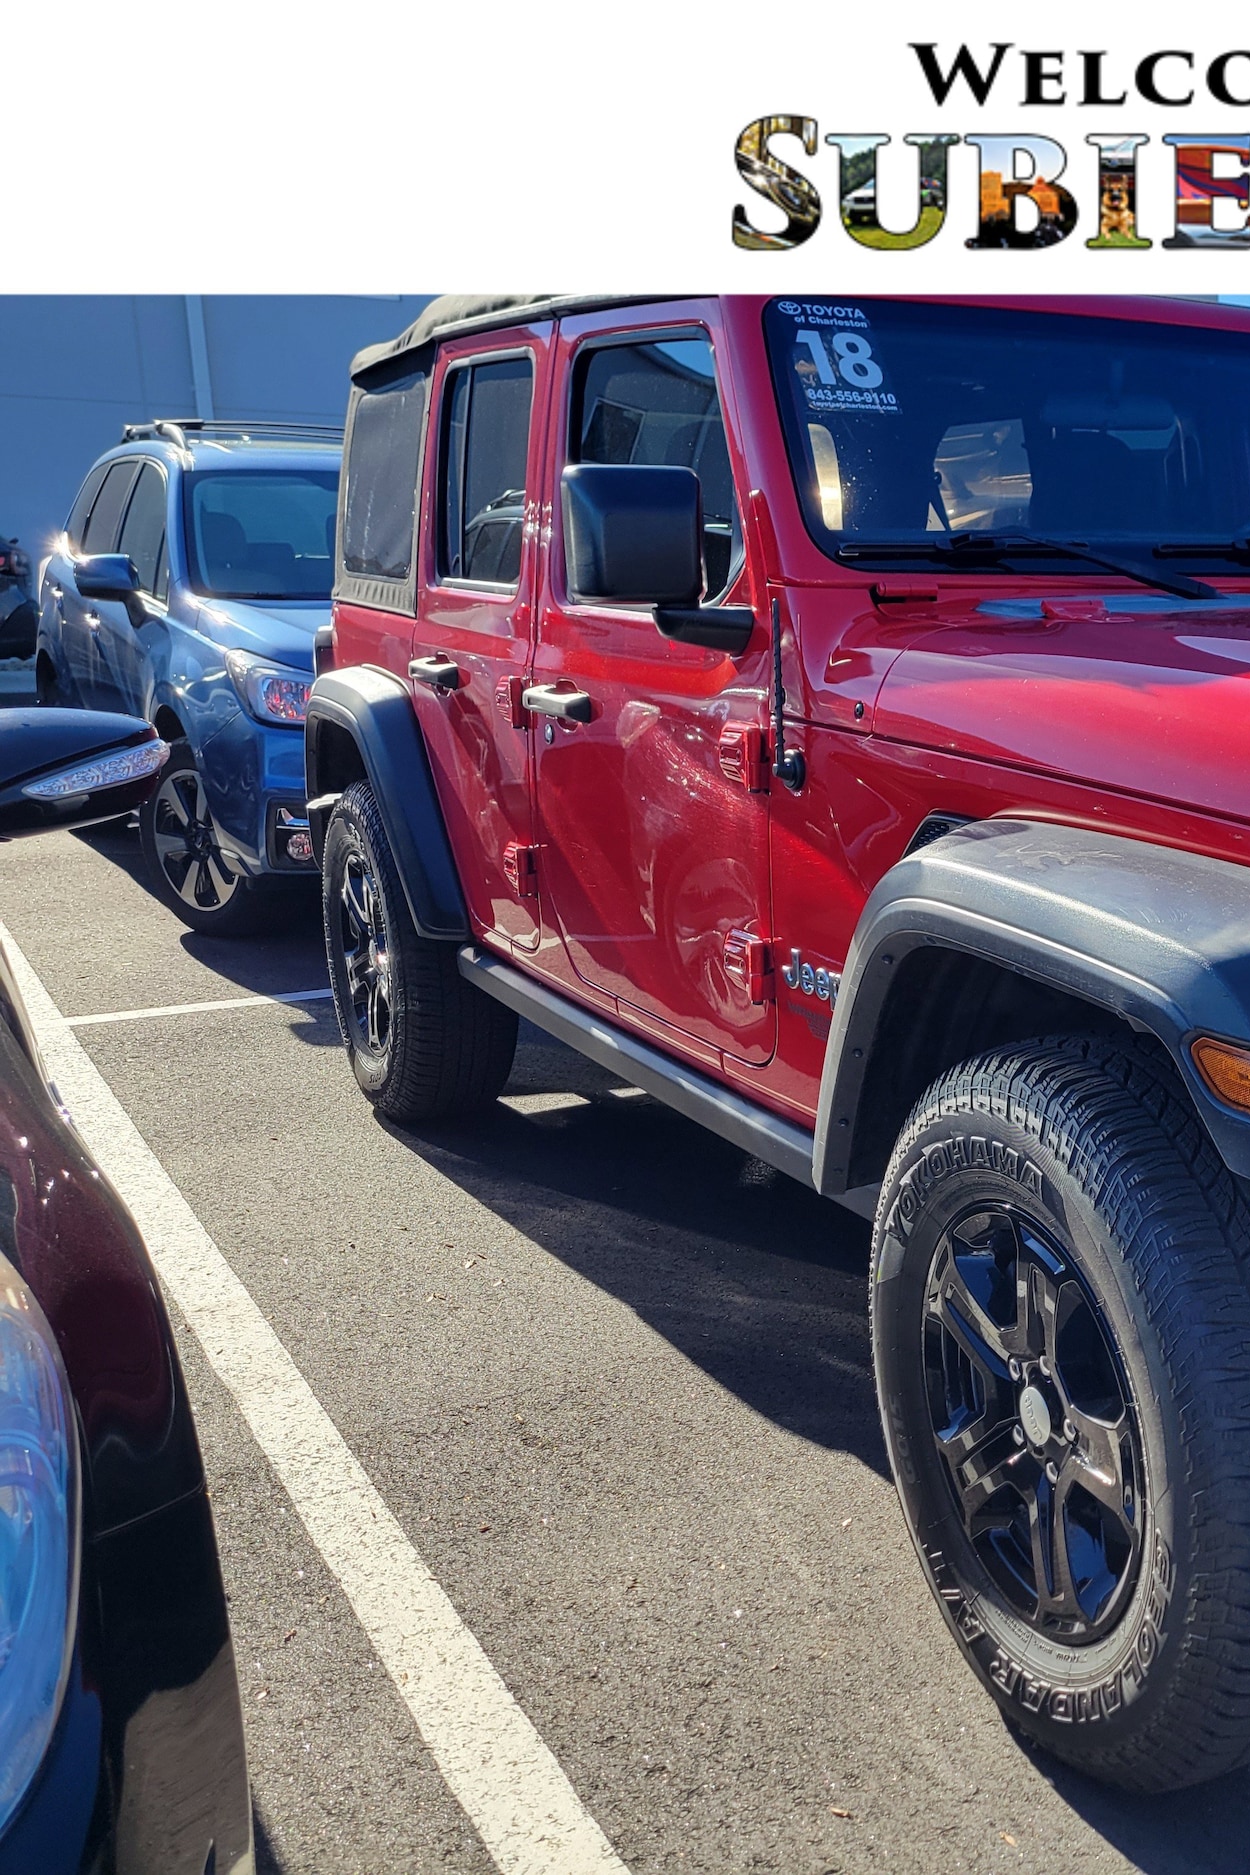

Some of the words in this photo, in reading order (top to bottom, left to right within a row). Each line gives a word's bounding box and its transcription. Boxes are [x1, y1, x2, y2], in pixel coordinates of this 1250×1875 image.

[801, 304, 866, 320] TOYOTA
[808, 316, 868, 328] Charleston
[796, 329, 884, 389] 18
[807, 388, 897, 405] 843-556-9110
[884, 1136, 1044, 1239] YOKOHAMA
